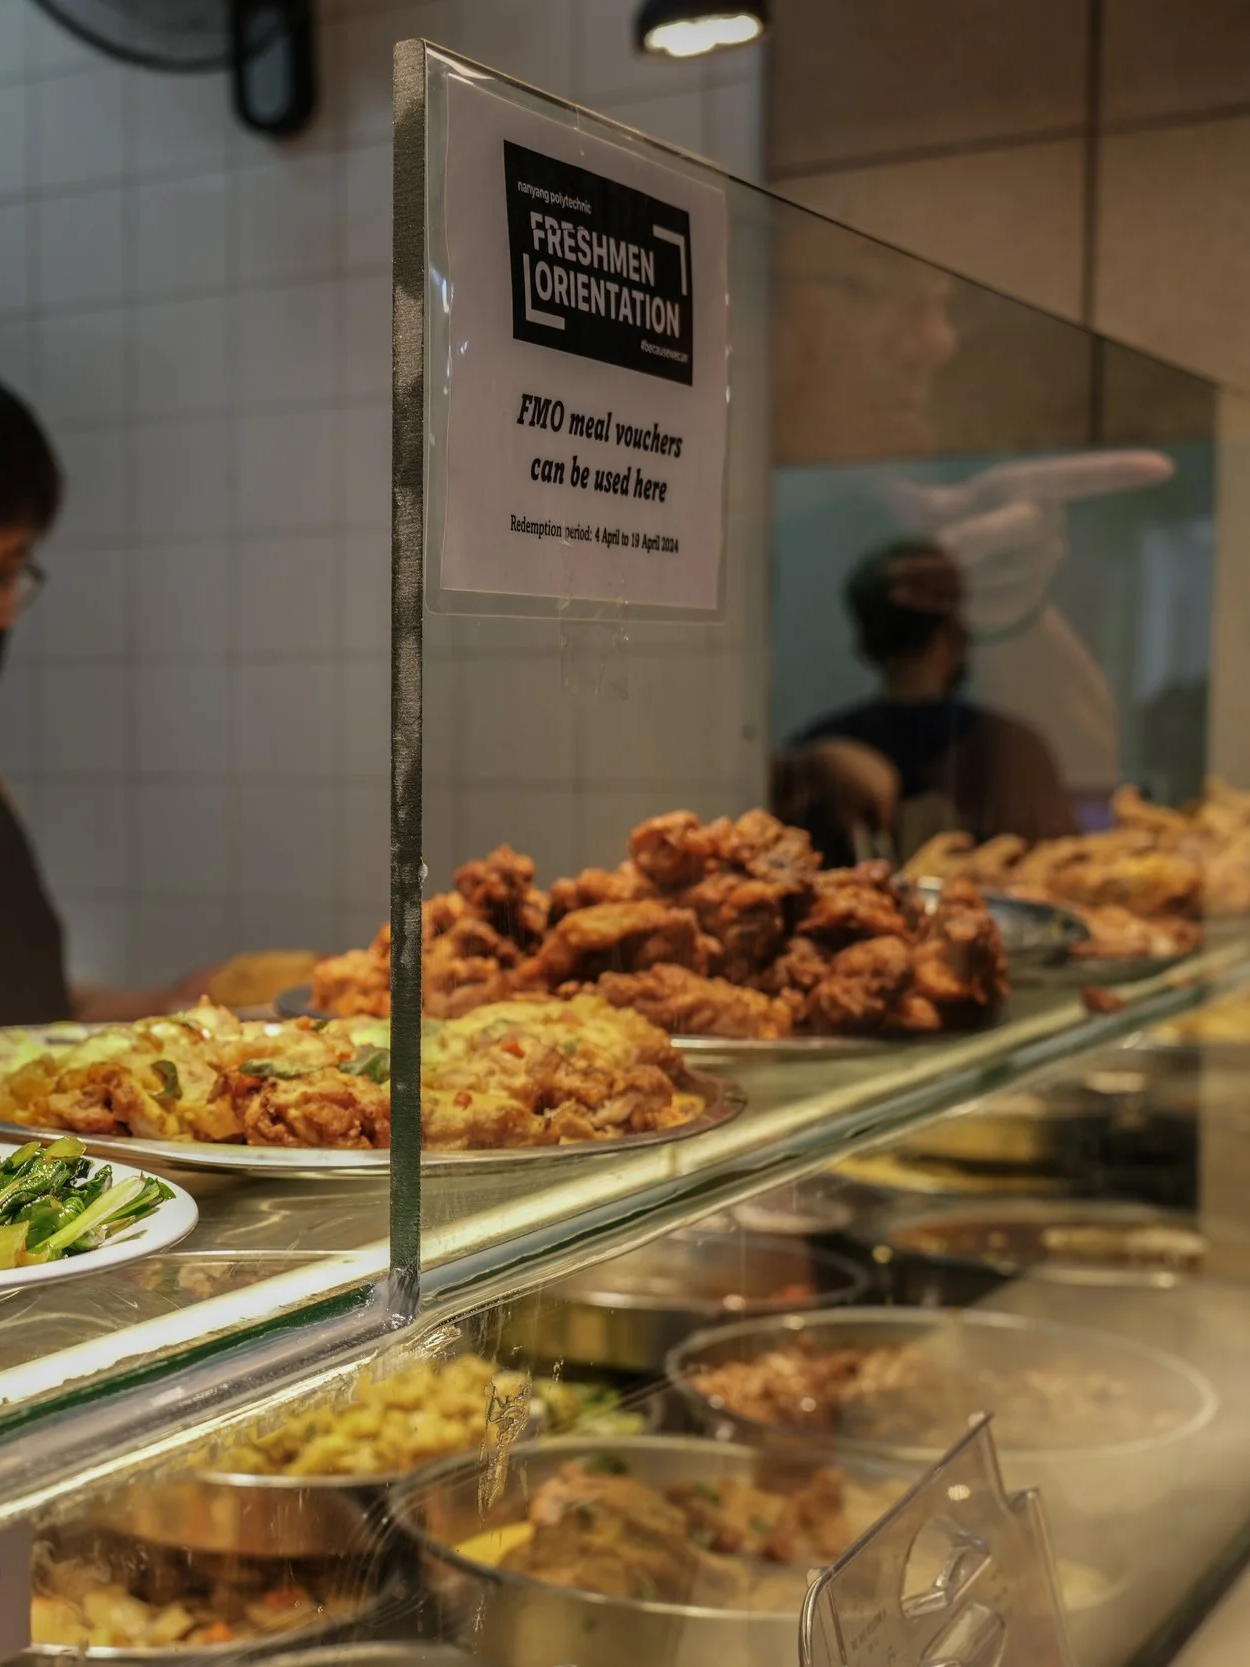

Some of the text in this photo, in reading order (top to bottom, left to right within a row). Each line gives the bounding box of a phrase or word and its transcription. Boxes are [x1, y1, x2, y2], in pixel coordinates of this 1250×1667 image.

[517, 181, 592, 214] nanyang polytechnic
[530, 211, 655, 287] FRESHMEN
[534, 260, 680, 339] ORIENTATION
[516, 393, 683, 458] FMO meal vouchers
[530, 455, 667, 503] can be used here
[510, 514, 678, 553] Redemption period: 4 April to 19 April 2024
